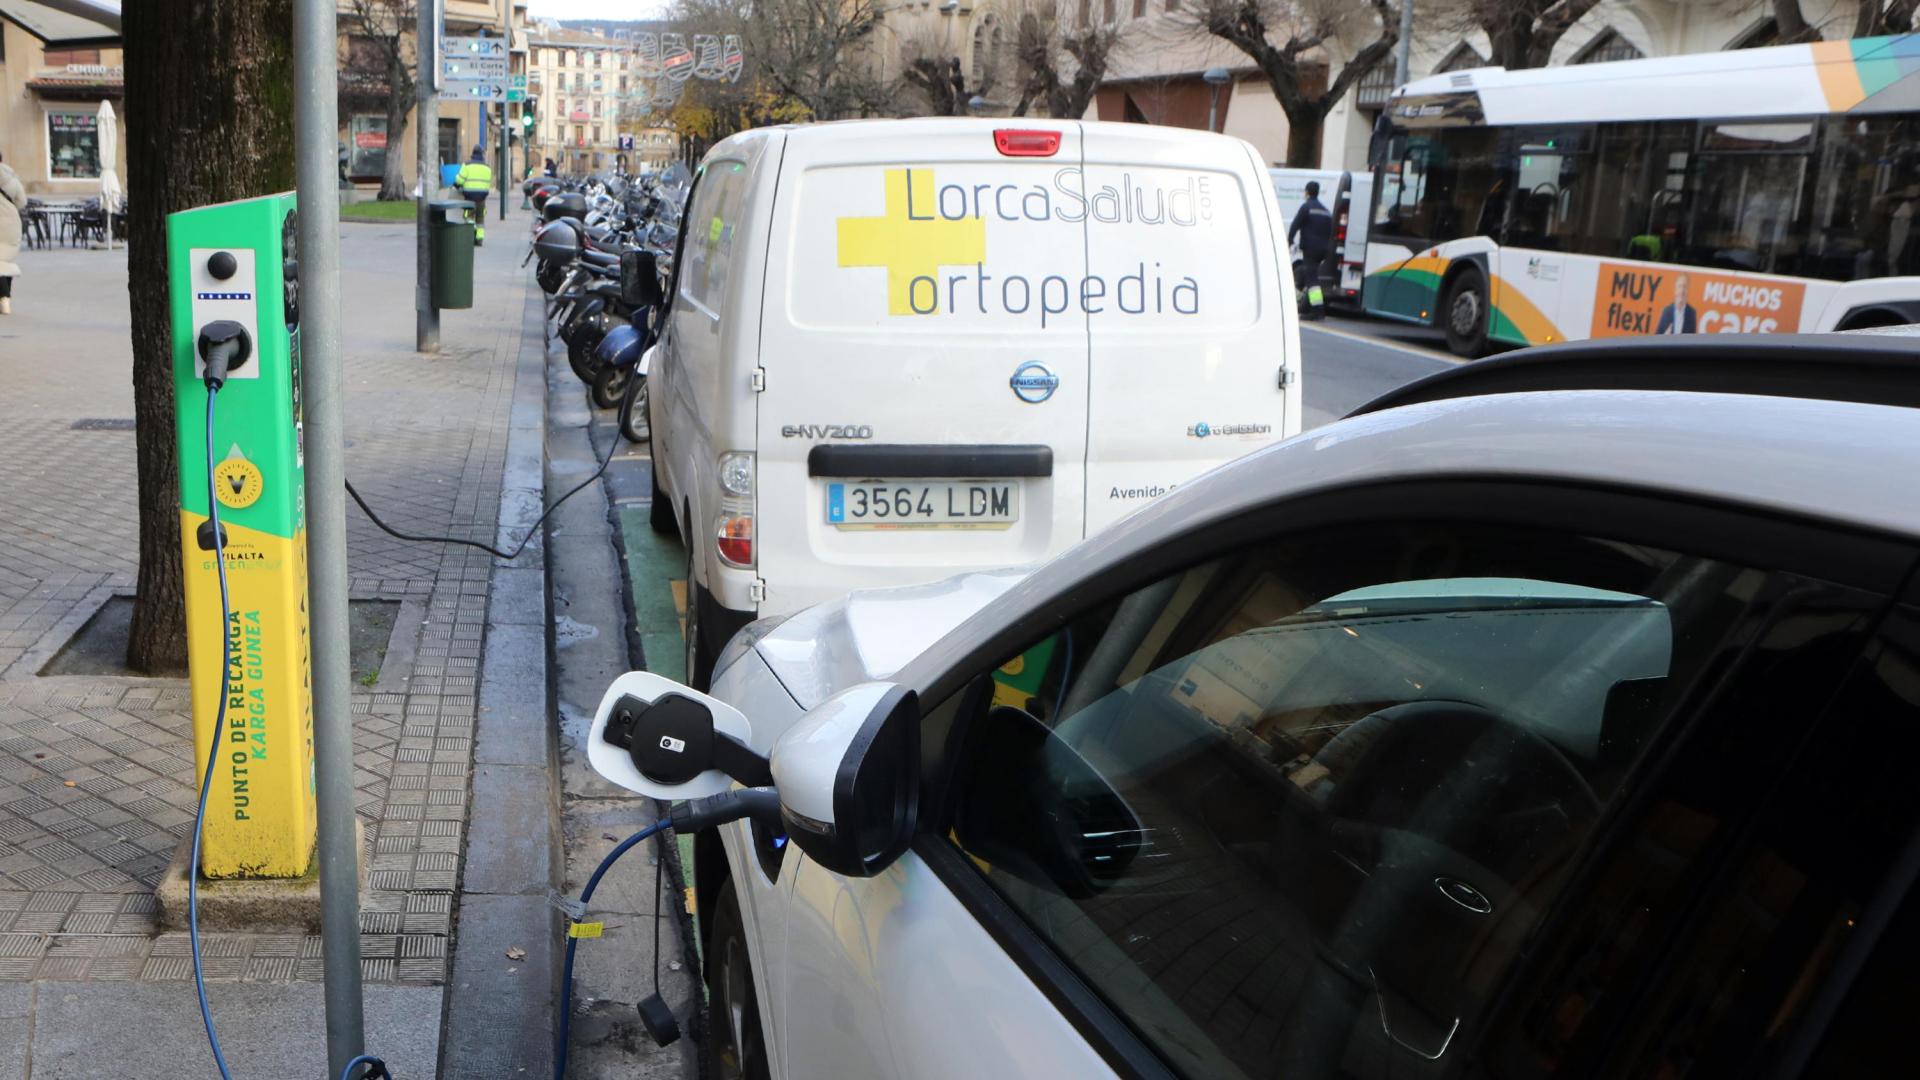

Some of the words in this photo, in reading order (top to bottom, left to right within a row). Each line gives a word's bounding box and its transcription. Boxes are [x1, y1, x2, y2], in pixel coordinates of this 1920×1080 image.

[909, 262, 1199, 328] ortopedia
[1610, 271, 1663, 301] MUY
[1703, 281, 1783, 311] MUCHOS
[1607, 303, 1653, 334] flexi
[1016, 378, 1054, 386] NISSAN
[781, 424, 874, 439] e-NV200
[851, 487, 934, 518] 3564
[948, 487, 1009, 517] LDM
[1110, 485, 1166, 499] Avenida
[228, 611, 244, 709] RECARGA
[245, 610, 263, 680] GUNEA
[231, 718, 246, 743] DE
[249, 687, 267, 760] KARGA
[232, 752, 250, 820] PUNTO
